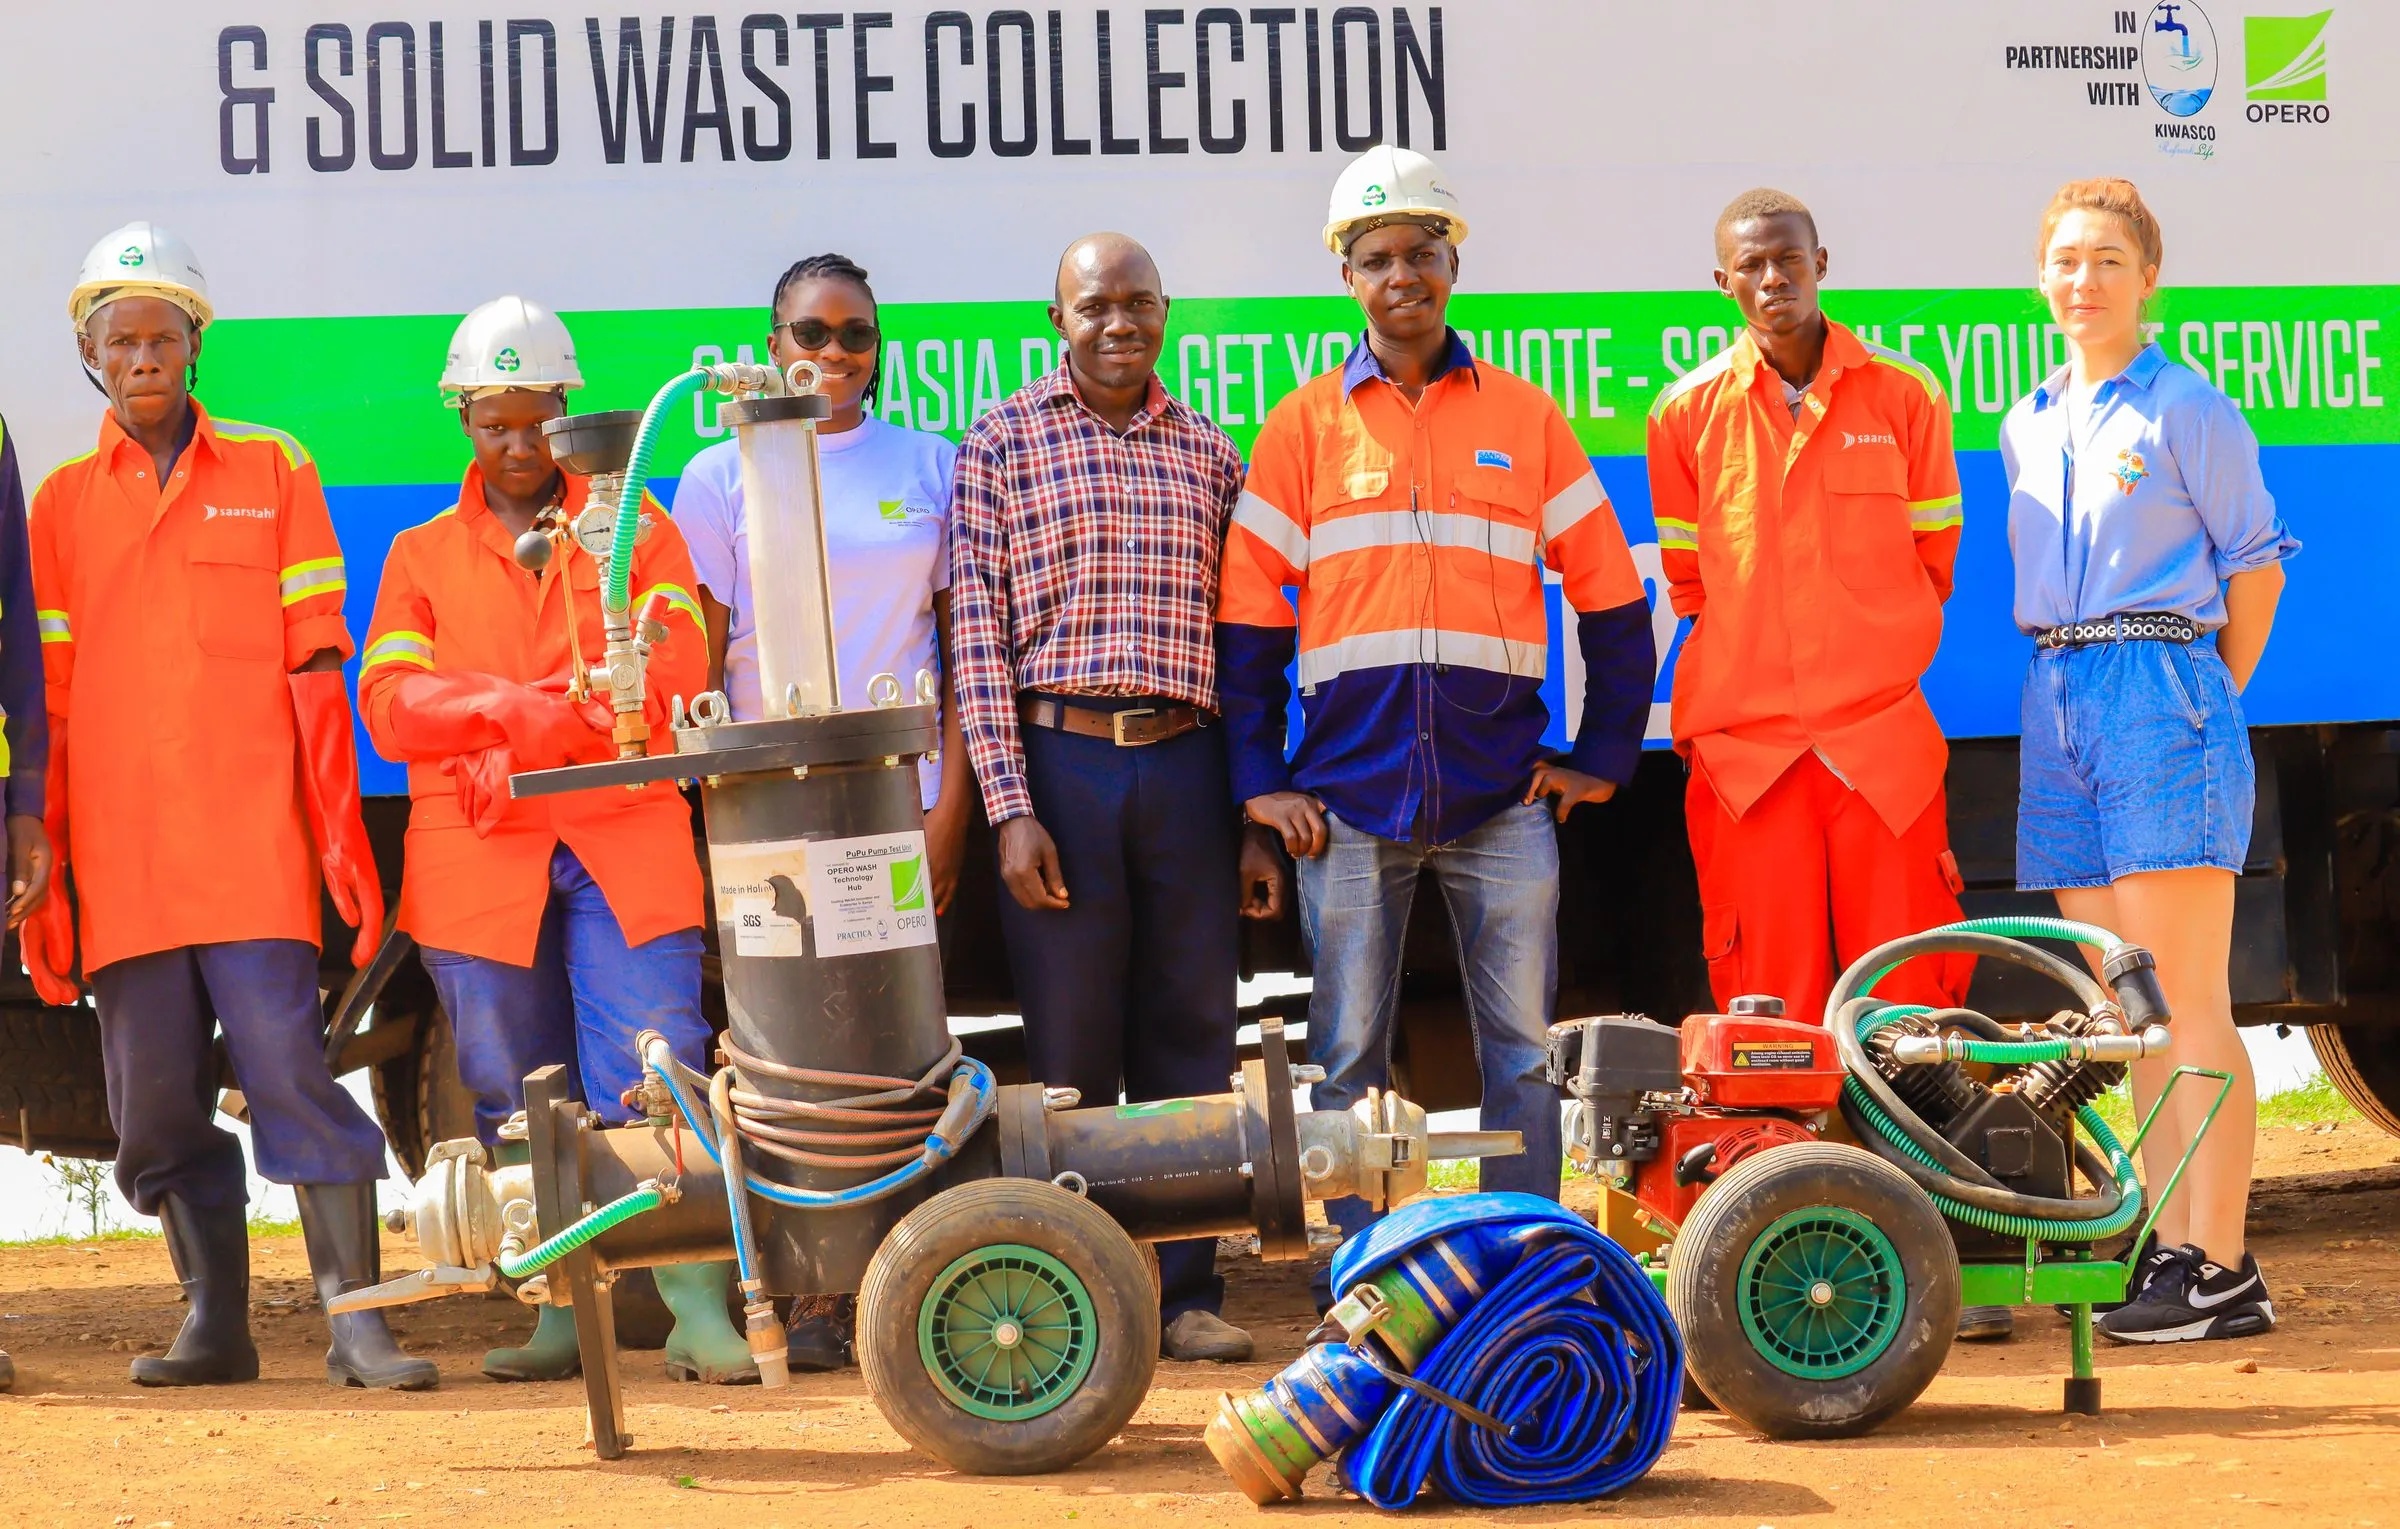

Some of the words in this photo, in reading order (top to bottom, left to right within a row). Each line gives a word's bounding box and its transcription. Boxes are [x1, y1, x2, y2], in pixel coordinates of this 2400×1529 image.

[2115, 11, 2137, 34] IN
[2006, 46, 2139, 70] PARTNERSHIP
[218, 25, 275, 175] &
[304, 18, 559, 173] SOLID
[585, 12, 897, 165] WASTE
[924, 7, 1447, 158] COLLECTION
[2087, 82, 2140, 106] WITH
[2246, 104, 2331, 124] OPERO
[2155, 124, 2216, 141] KIWASCO
[1179, 332, 1273, 425] GET
[2179, 319, 2384, 411] SERVICE
[220, 507, 275, 519] saarstahl
[846, 849, 866, 858] PuPu
[868, 847, 888, 856] Pump
[889, 845, 901, 853] Test
[827, 866, 855, 875] OPERO
[856, 863, 877, 873] WASH
[833, 873, 874, 884] Technology
[720, 885, 737, 895] Made
[738, 884, 745, 894] in
[743, 914, 761, 927] SGS
[897, 914, 927, 930] OPERO
[837, 929, 873, 940] PRACTICA
